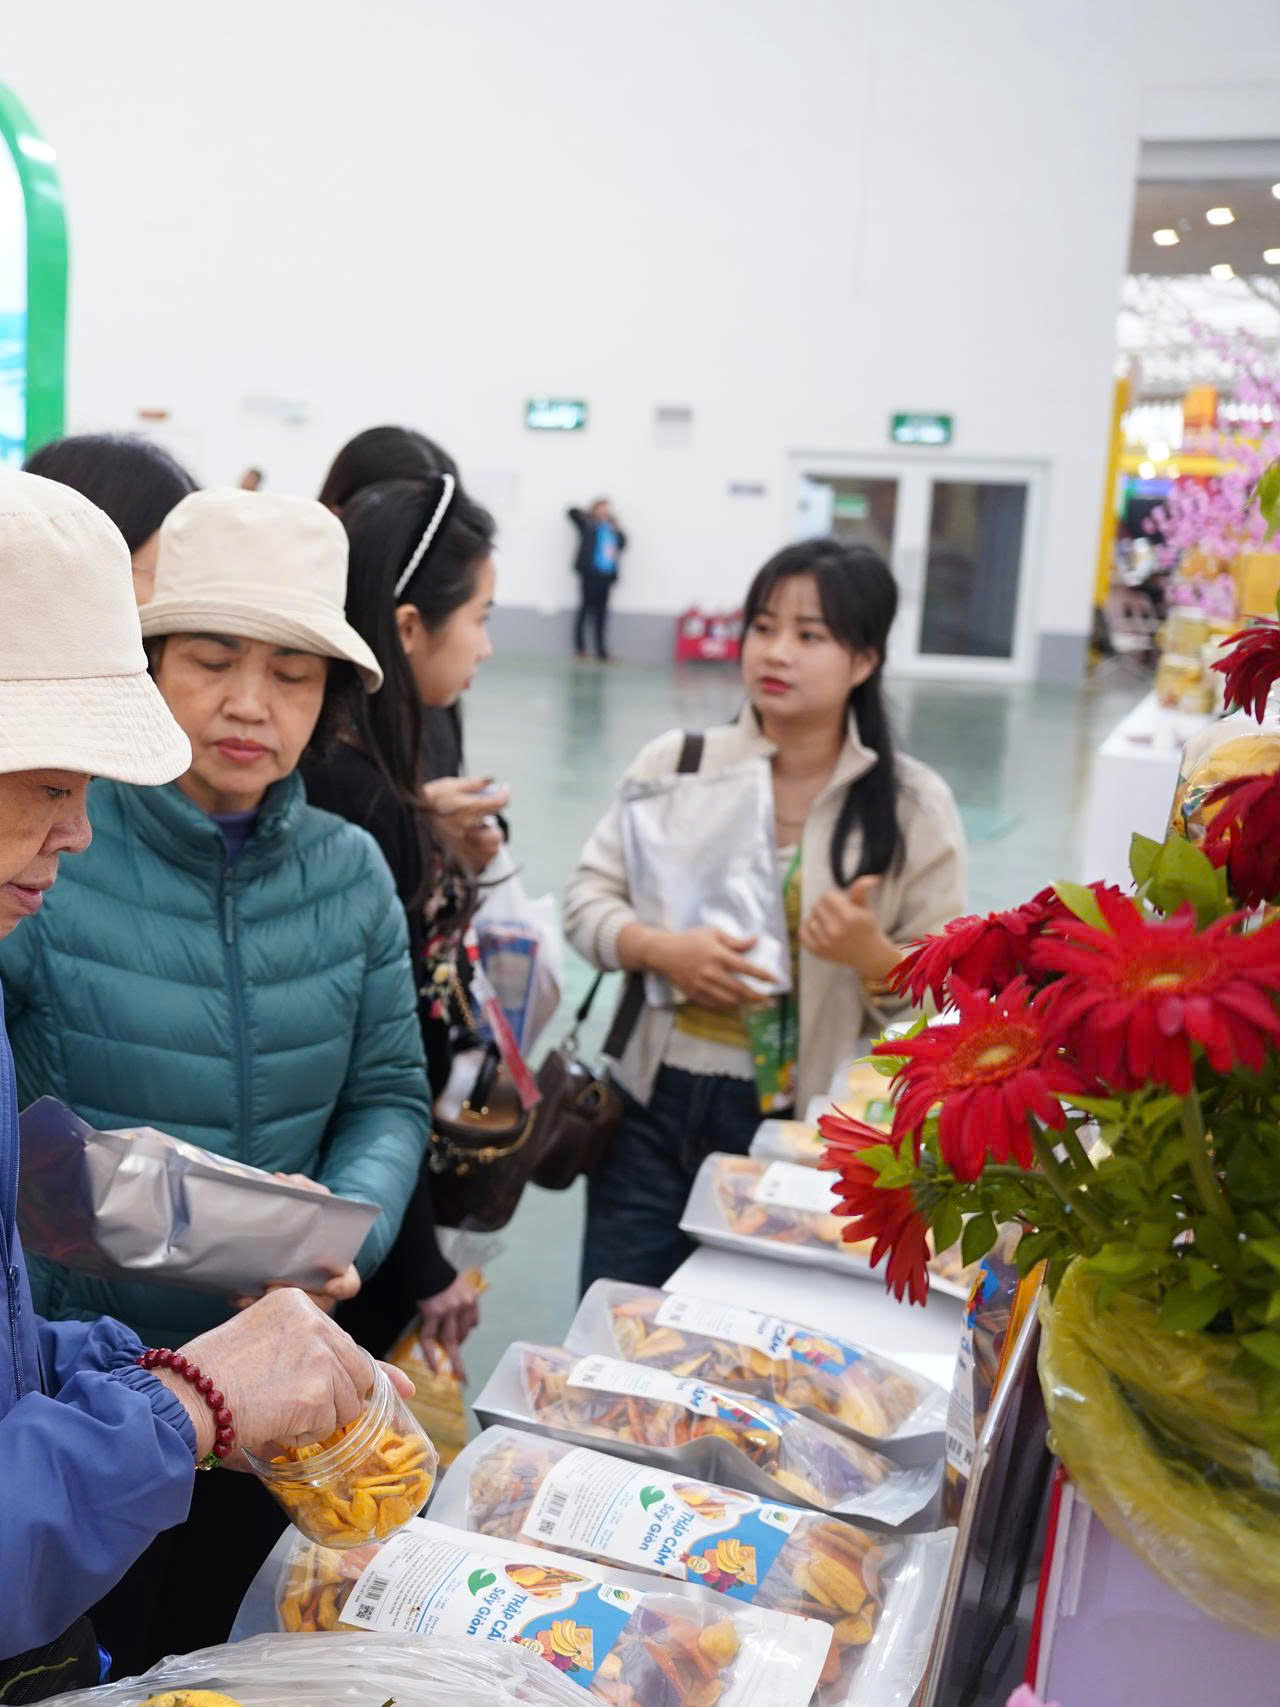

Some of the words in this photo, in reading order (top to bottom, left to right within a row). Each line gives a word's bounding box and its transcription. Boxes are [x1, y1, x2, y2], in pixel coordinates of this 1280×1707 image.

[638, 1523, 662, 1551] Giòn
[654, 1536, 677, 1566] CẨM
[483, 1586, 506, 1606] Sấy
[501, 1593, 528, 1620] THẬP
[466, 1606, 491, 1636] Giòn
